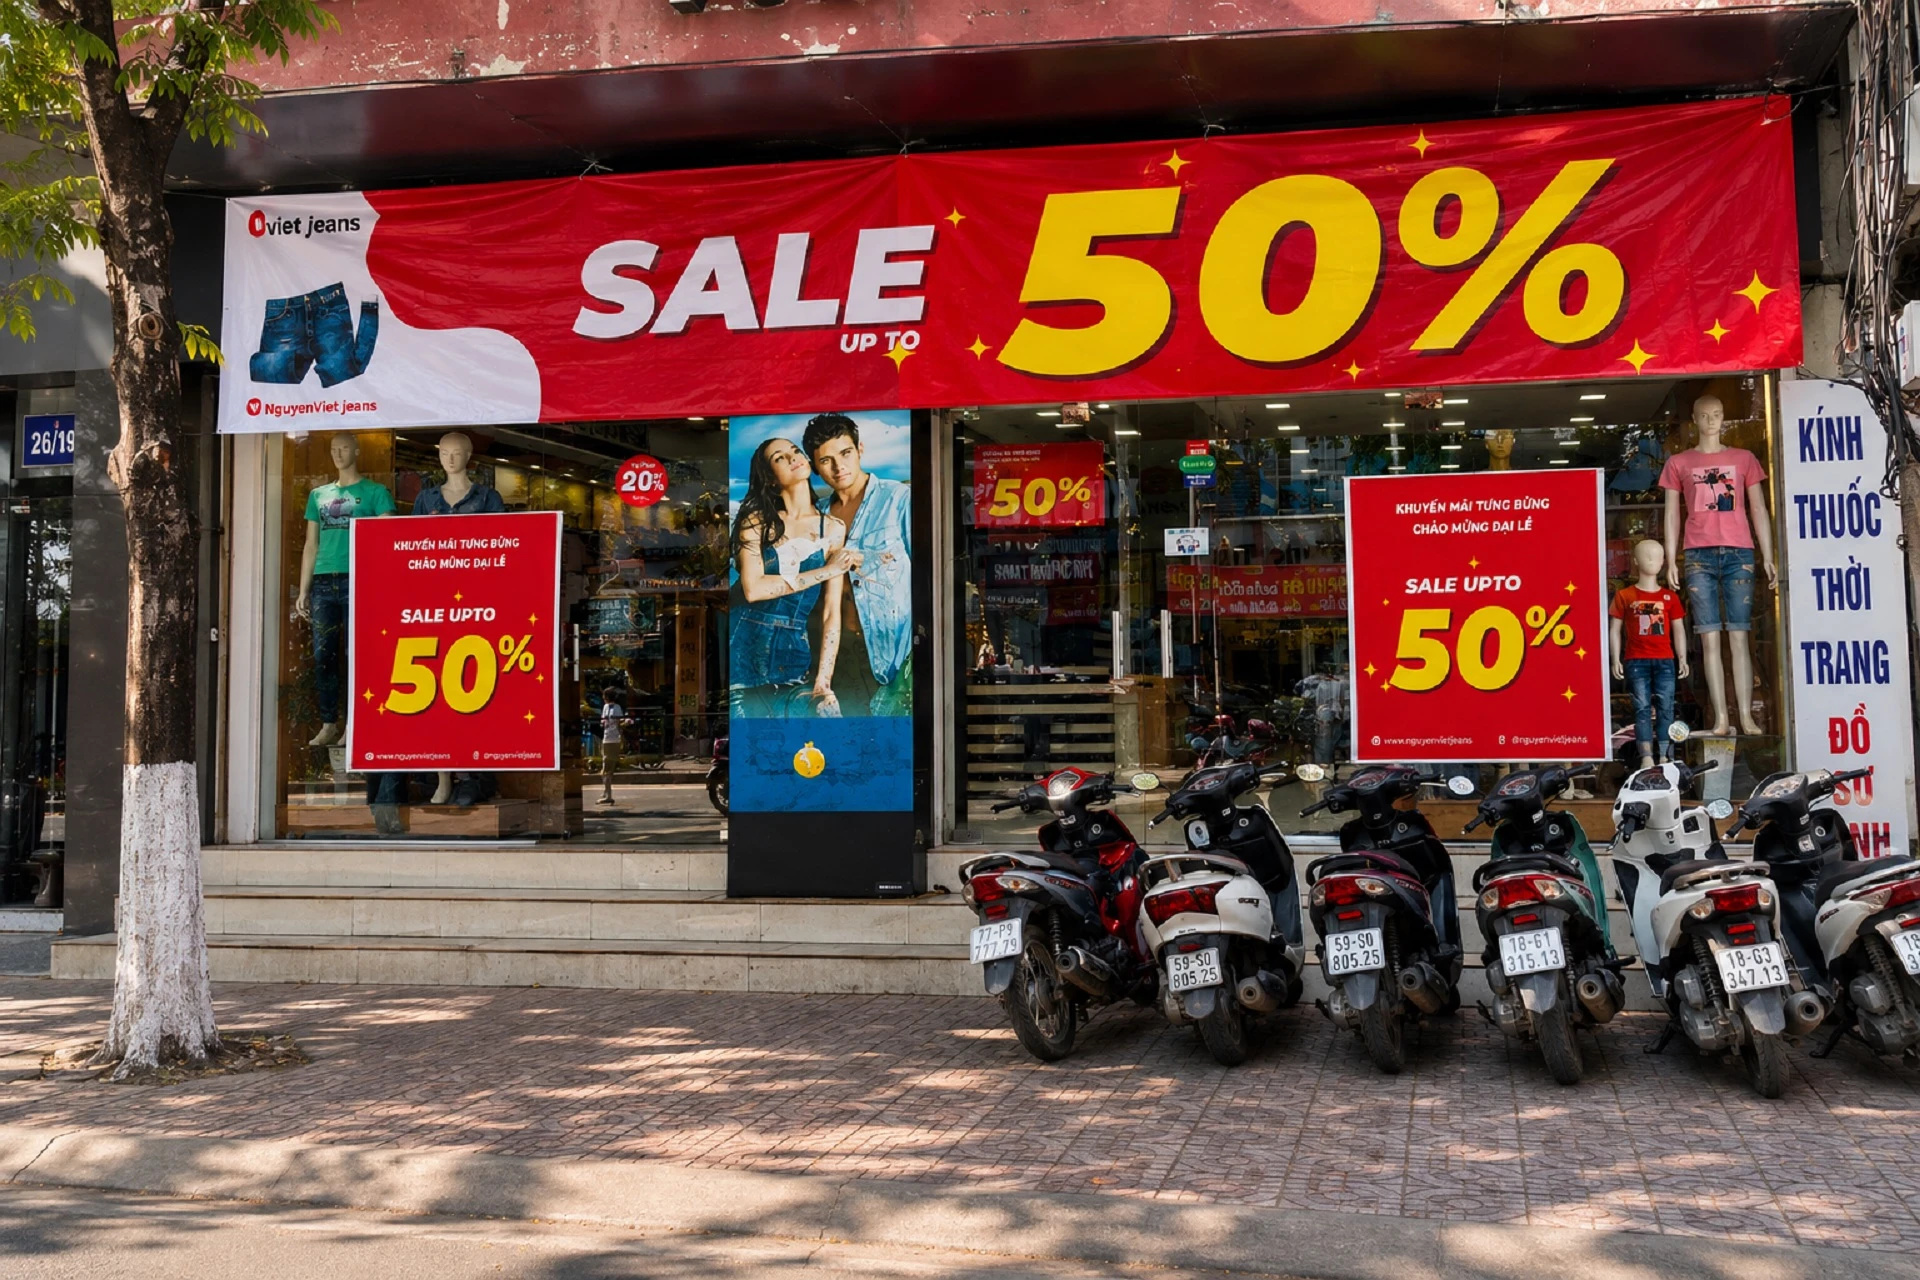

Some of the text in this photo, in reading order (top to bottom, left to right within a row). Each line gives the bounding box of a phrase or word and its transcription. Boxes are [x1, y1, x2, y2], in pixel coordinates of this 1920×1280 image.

[305, 215, 360, 239] jeans
[997, 157, 1627, 377] 50%
[572, 225, 936, 341] SALE
[840, 330, 920, 354] UP TO
[265, 400, 377, 417] NguyenViet jeans
[31, 429, 75, 455] 26/19
[1798, 405, 1864, 463] KÍNH
[988, 475, 1091, 517] 50%
[1794, 476, 1882, 539] THUỐC
[1404, 575, 1523, 594] SALE UPTO
[1811, 555, 1872, 611] THỜI
[400, 607, 496, 624] SALE UPTO
[1389, 605, 1576, 692] 50%
[385, 634, 536, 715] 50%
[1801, 639, 1890, 685] TRANG
[1828, 703, 1871, 755] ĐỒ
[978, 923, 1013, 943] 77-P9
[975, 938, 1018, 960] 777.79
[1333, 949, 1380, 971] 805.25
[1507, 949, 1560, 972] 315.13
[1173, 967, 1218, 989] 805.25
[1727, 964, 1783, 989] 347.13
